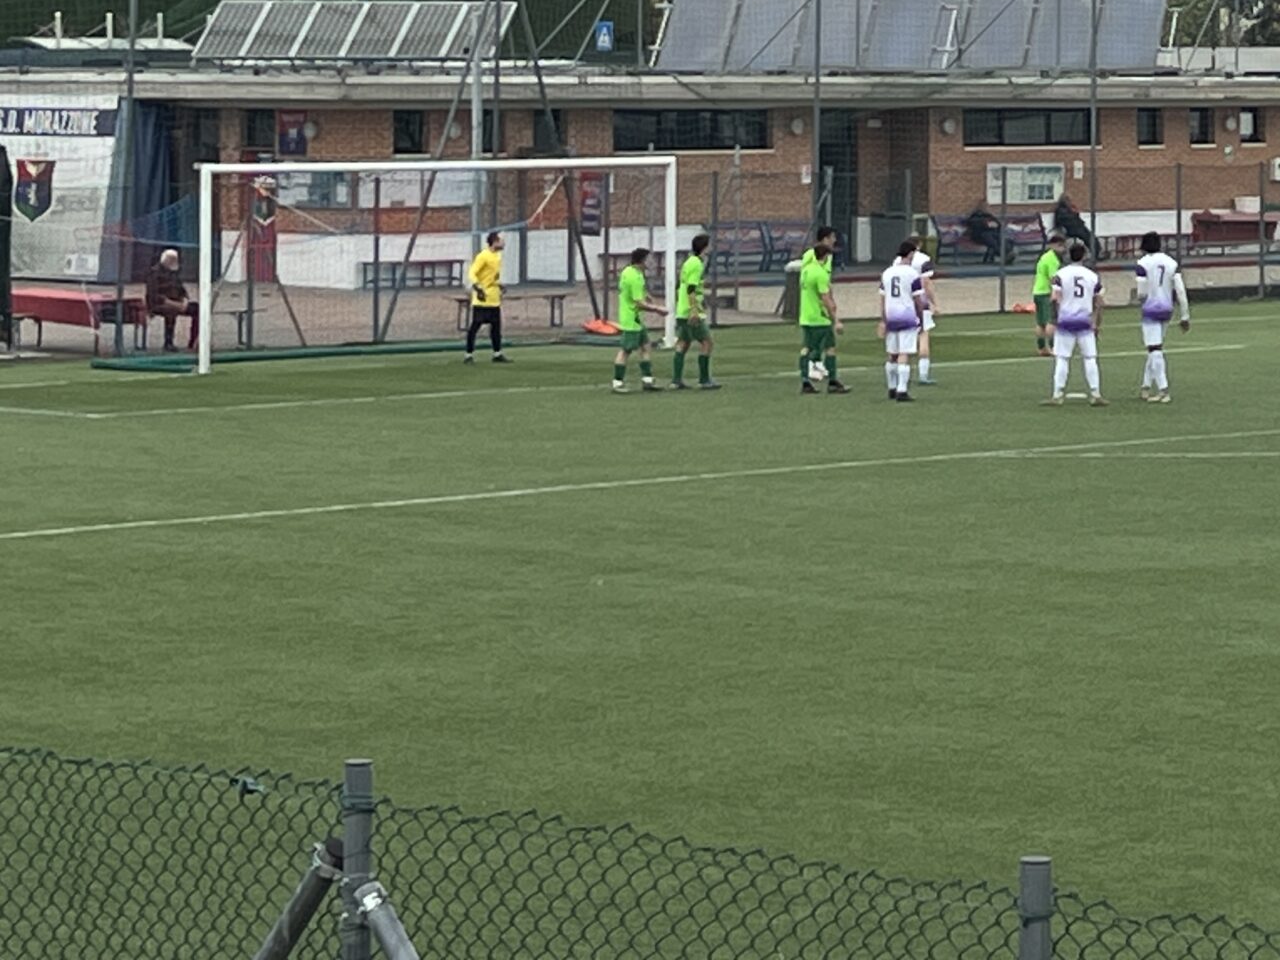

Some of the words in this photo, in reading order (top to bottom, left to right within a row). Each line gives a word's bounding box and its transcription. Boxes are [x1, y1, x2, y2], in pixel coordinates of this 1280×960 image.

[1157, 264, 1165, 287] 7
[891, 276, 900, 298] 6
[1073, 276, 1084, 298] 5
